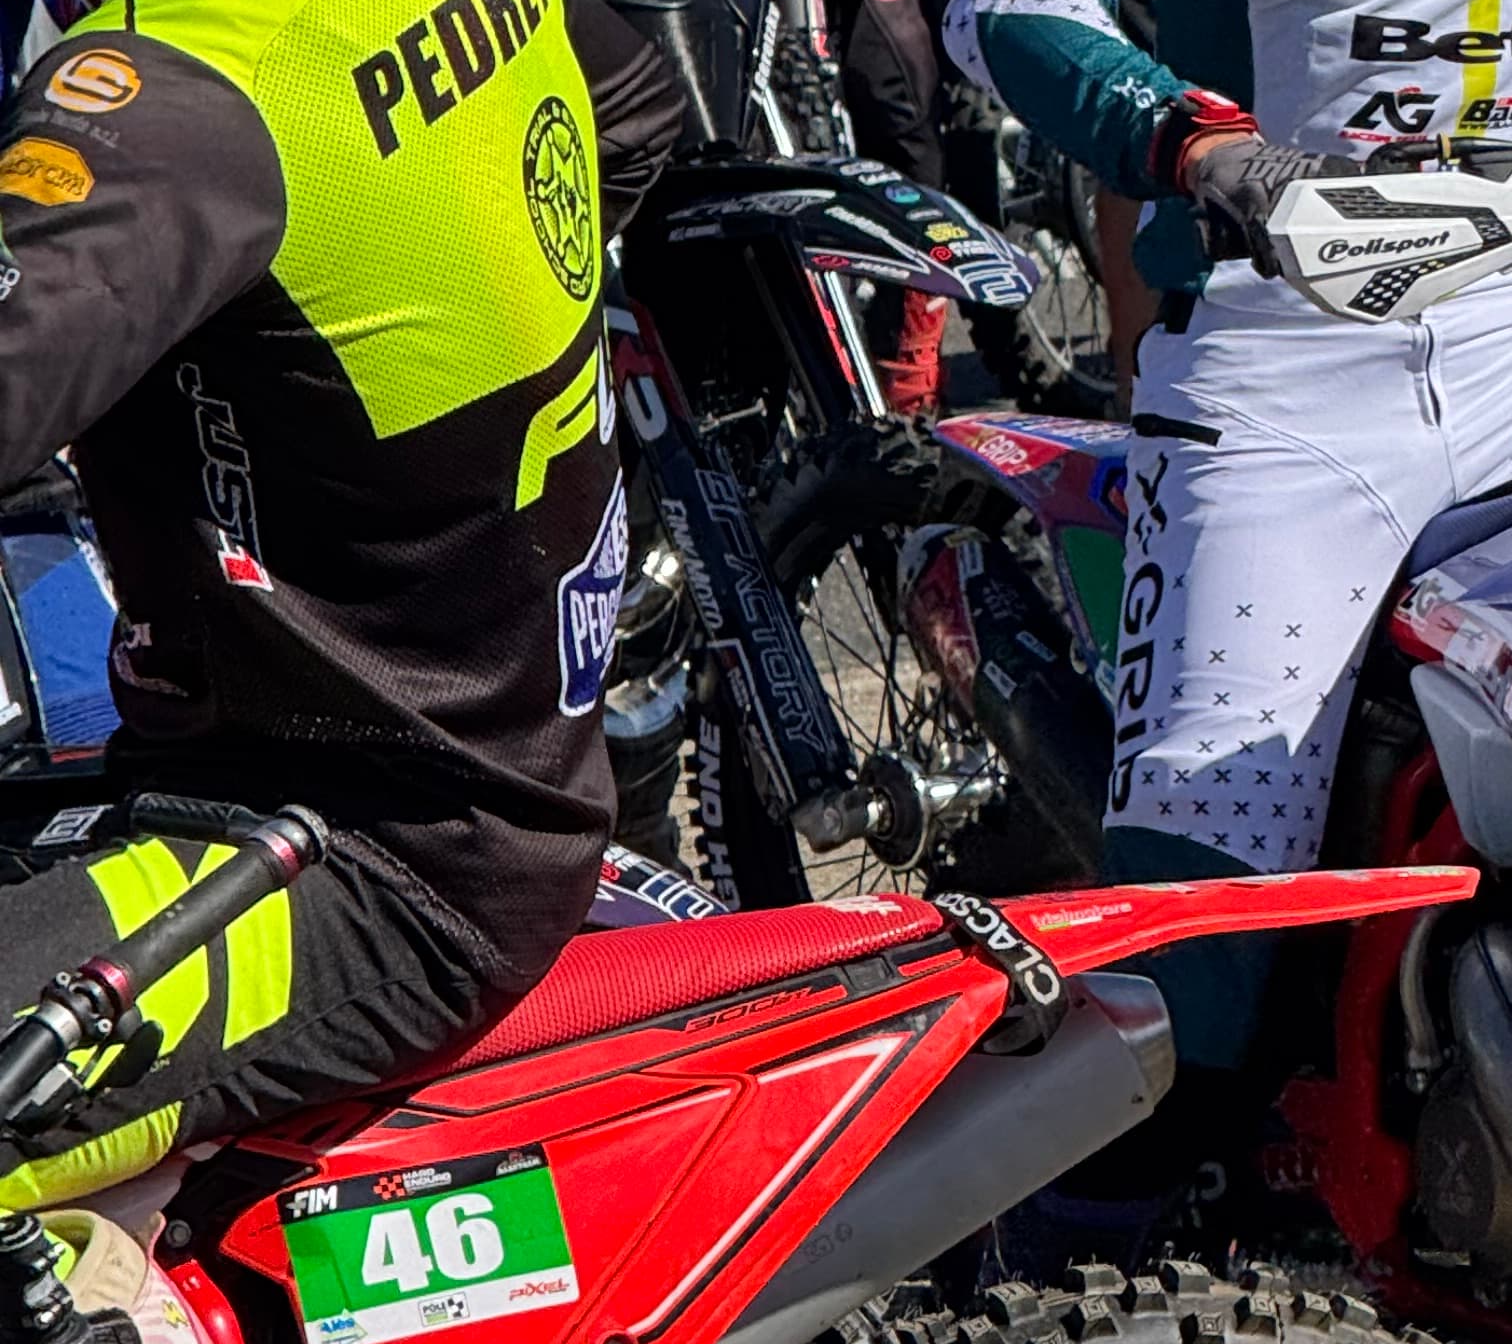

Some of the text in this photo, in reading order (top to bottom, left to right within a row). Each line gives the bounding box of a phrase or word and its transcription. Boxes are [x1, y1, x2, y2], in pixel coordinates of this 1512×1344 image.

[1319, 231, 1451, 264] Polisport
[285, 1186, 338, 1219] FIM
[361, 1192, 505, 1293] 46
